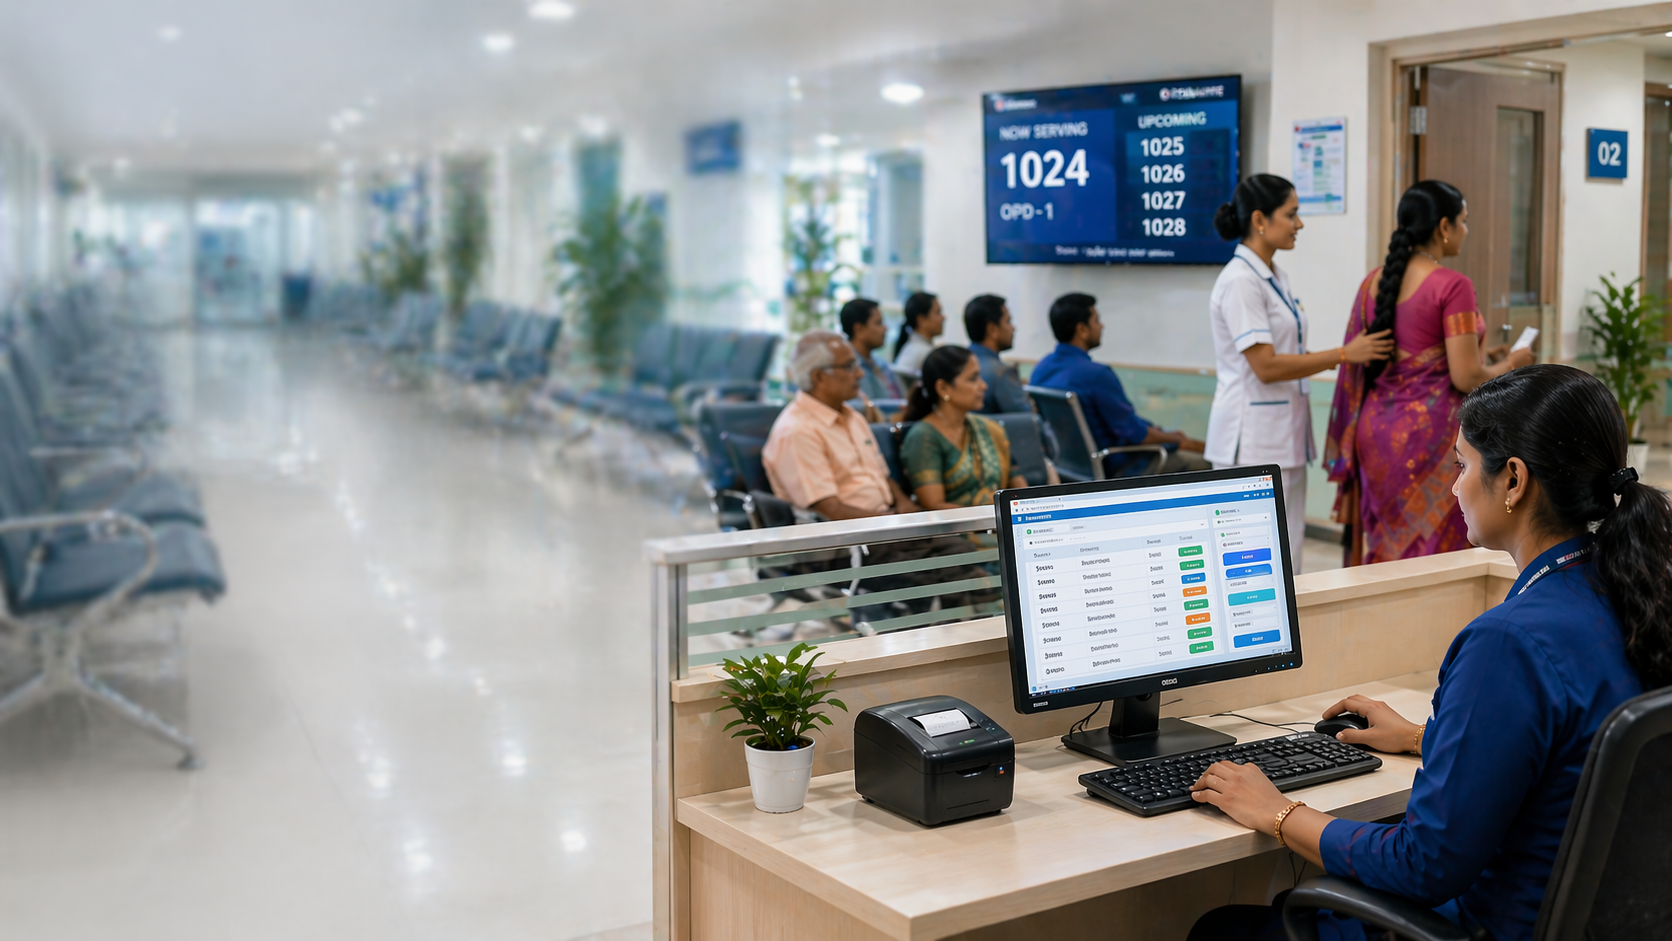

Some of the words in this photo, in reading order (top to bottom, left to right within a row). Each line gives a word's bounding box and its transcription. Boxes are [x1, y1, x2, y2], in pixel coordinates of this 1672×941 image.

[1137, 112, 1207, 129] UPCOMING
[999, 125, 1032, 141] NOW
[1033, 121, 1089, 138] SERVING
[1140, 136, 1185, 157] 1025
[1597, 141, 1622, 167] 02
[1000, 149, 1090, 189] 1024
[1140, 164, 1186, 184] 1026
[1141, 191, 1186, 211] 1027
[1142, 218, 1187, 237] 1028
